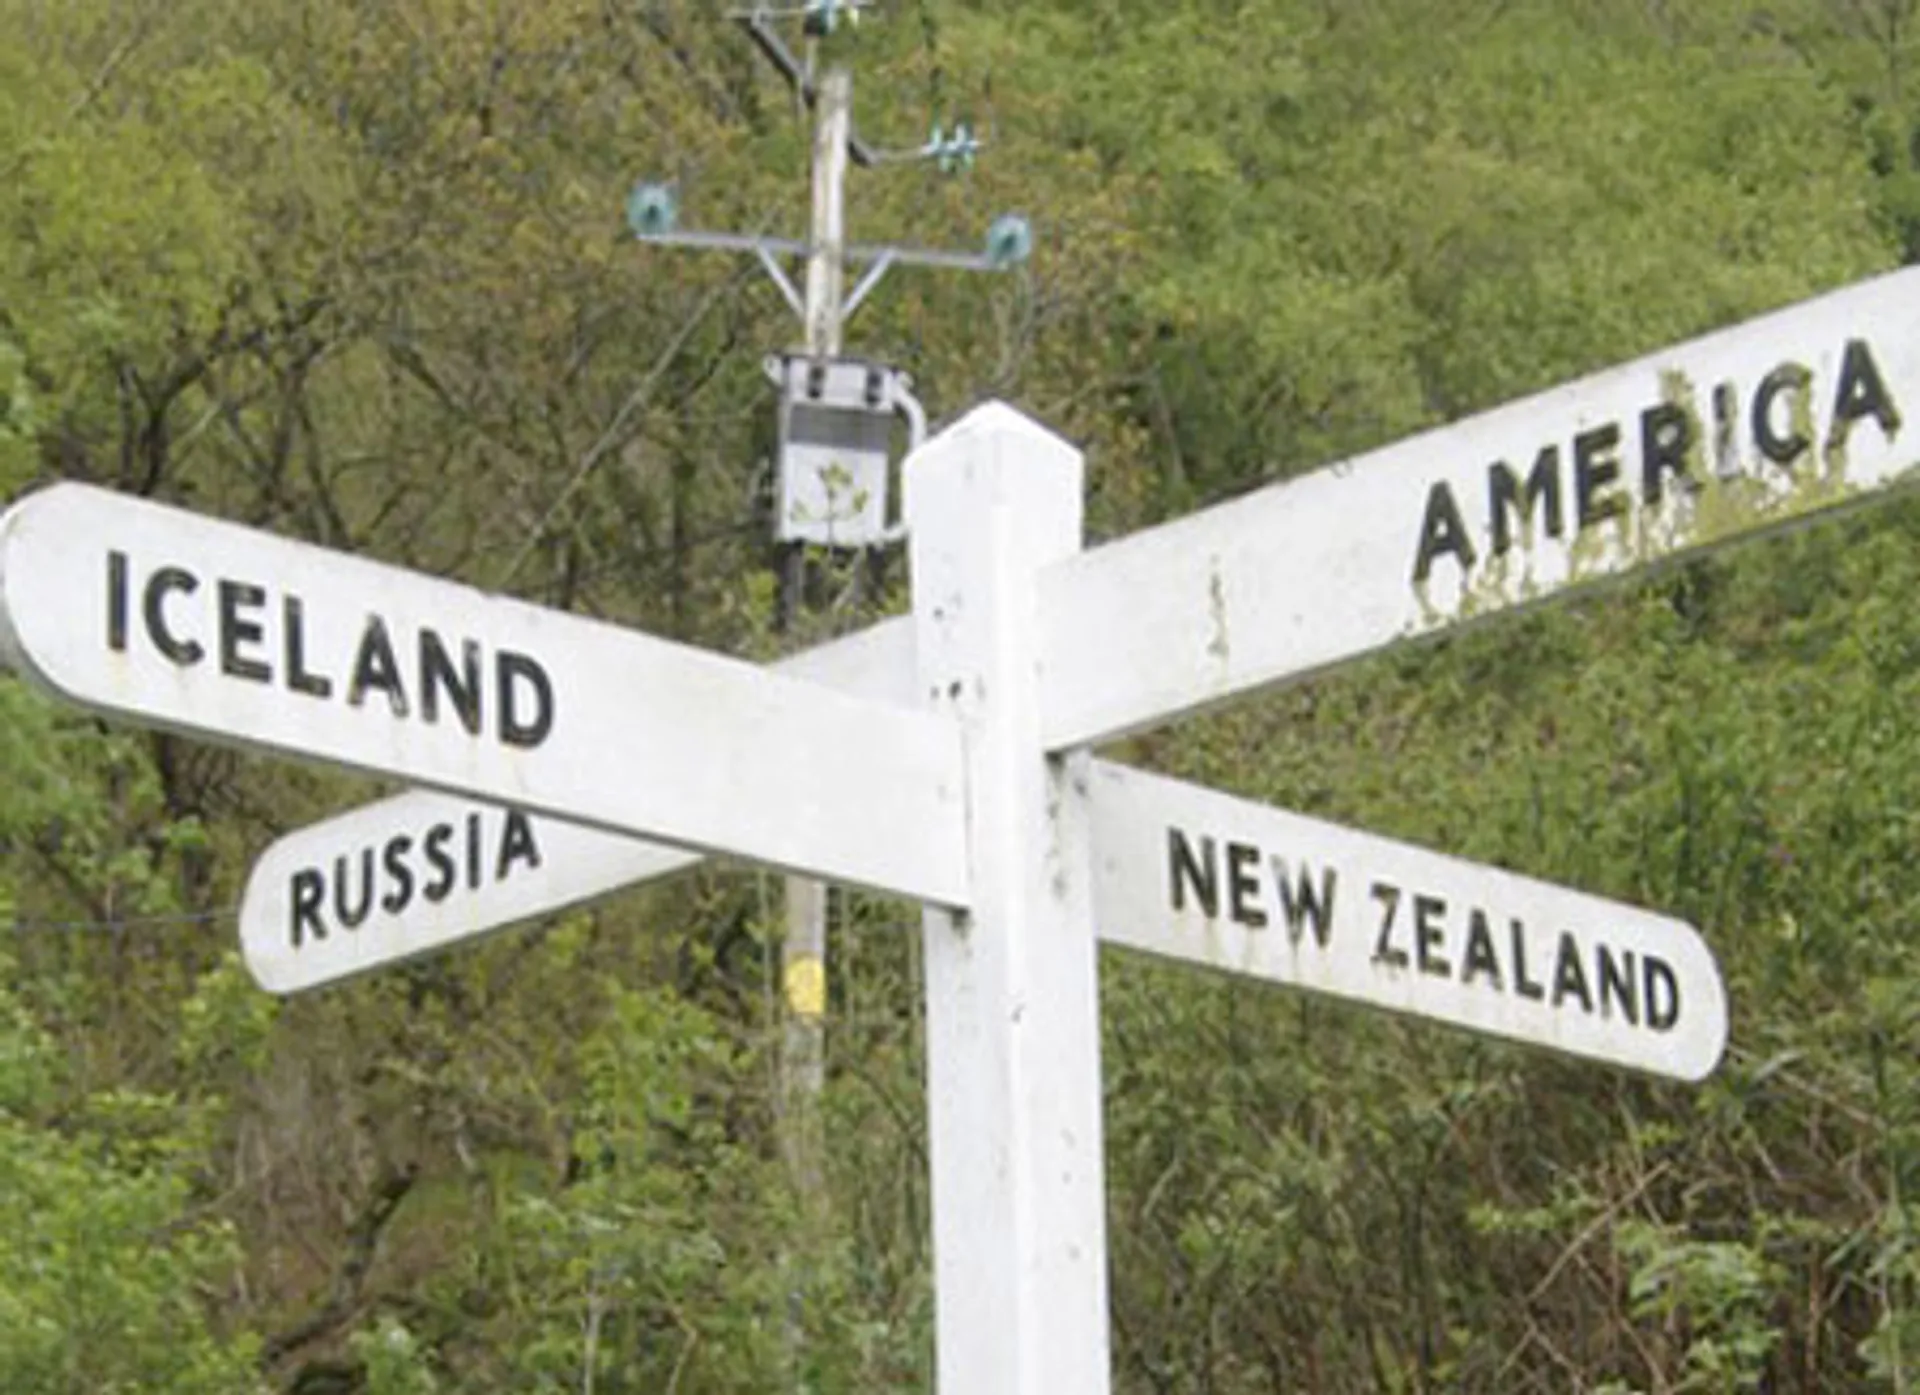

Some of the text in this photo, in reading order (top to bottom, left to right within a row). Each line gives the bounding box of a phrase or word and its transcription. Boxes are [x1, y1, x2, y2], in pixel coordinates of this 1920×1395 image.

[1411, 337, 1901, 583] AMERICA
[106, 549, 555, 750] ICELAND
[289, 808, 541, 948] RUSSIA
[1166, 826, 1681, 1033] NEW ZEALAND
